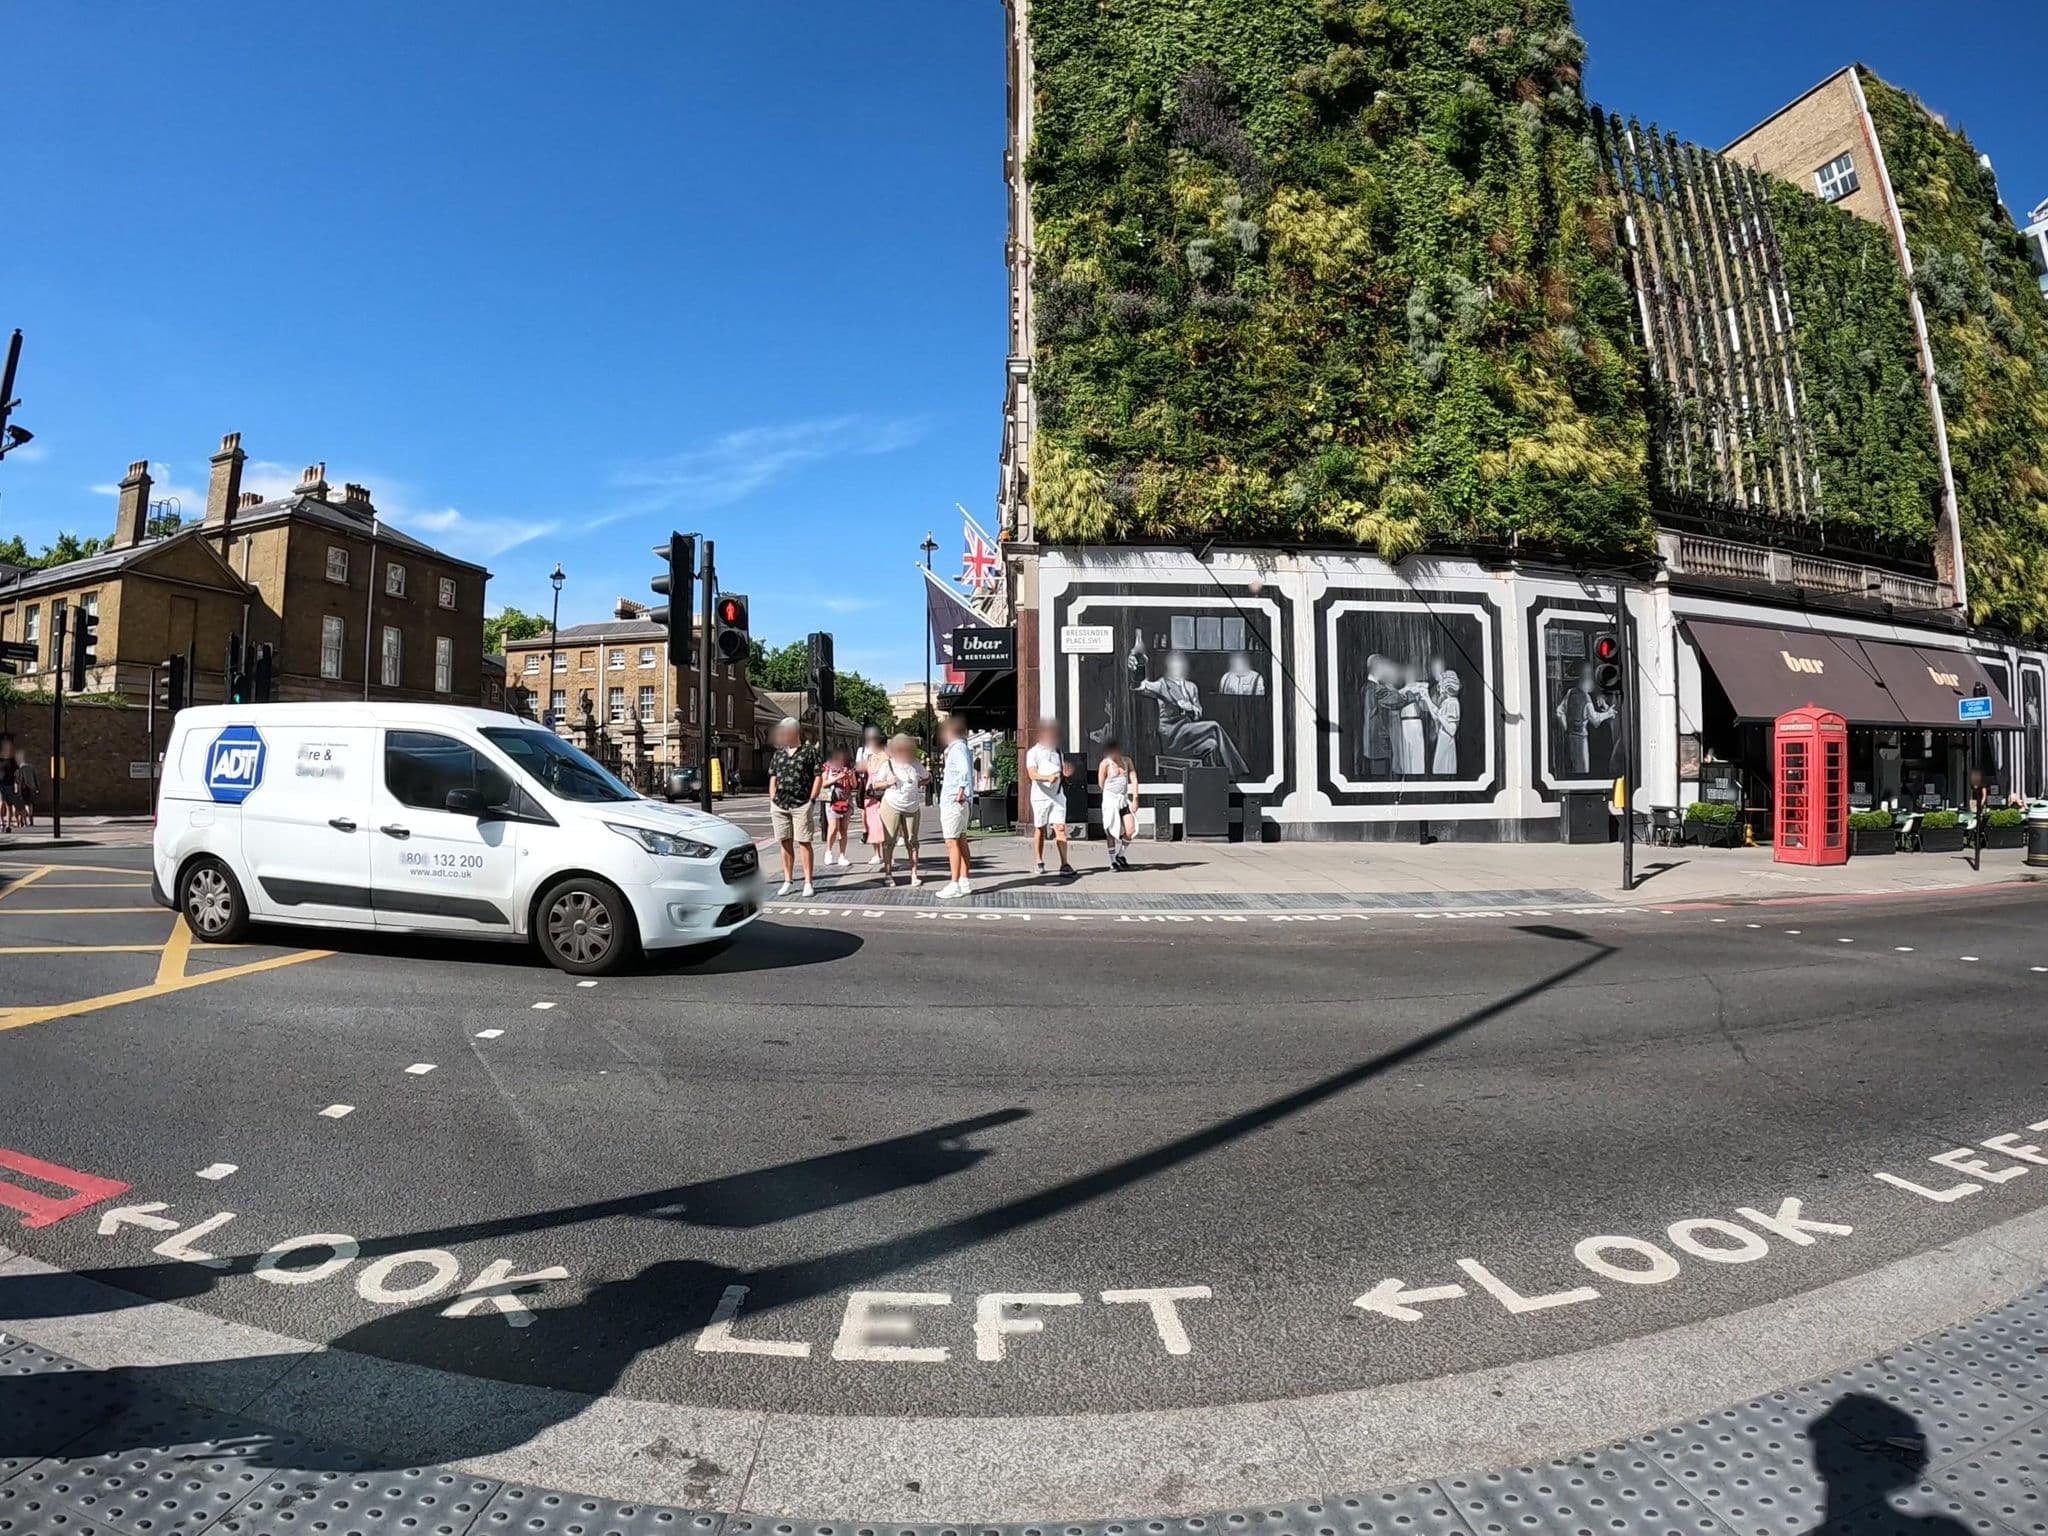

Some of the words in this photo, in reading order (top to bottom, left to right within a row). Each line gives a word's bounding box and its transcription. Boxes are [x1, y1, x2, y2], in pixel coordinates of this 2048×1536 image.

[962, 636, 1002, 650] bbar
[1779, 650, 1825, 674] bar
[1926, 666, 1960, 687] bar
[323, 748, 332, 761] &
[214, 748, 257, 779] ADT
[400, 852, 429, 866] 80
[433, 854, 456, 867] 132
[459, 855, 484, 868] 200
[409, 868, 472, 878] www.adt.co.uk
[913, 911, 1031, 921] LOOK
[1113, 914, 1248, 922] RIGHT
[1456, 1197, 1853, 1313] LOOK
[152, 1211, 569, 1328] LOOK
[694, 1285, 1212, 1363] LEFT
